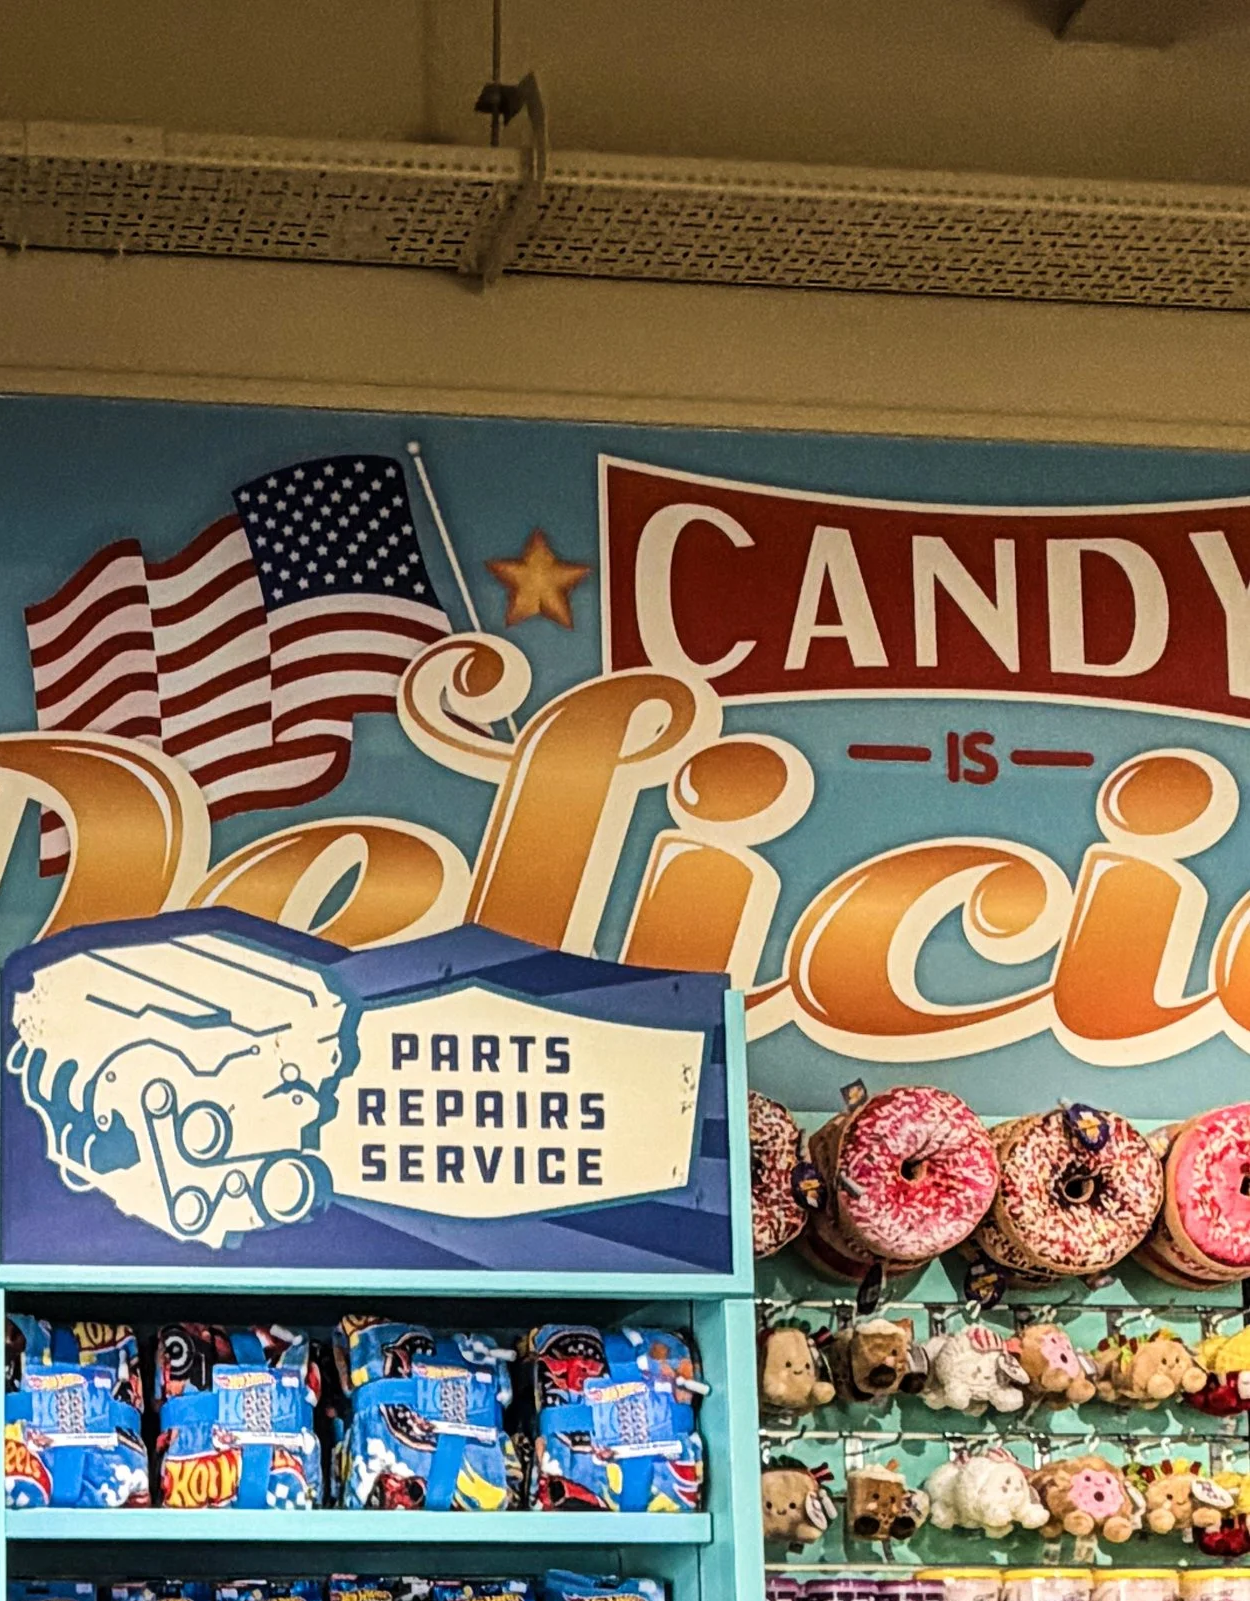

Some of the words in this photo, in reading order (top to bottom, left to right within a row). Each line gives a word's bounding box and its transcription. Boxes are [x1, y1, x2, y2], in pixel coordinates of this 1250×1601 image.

[947, 731, 999, 785] IS
[391, 1032, 571, 1074] PARTS
[357, 1087, 605, 1130] REPAIRS
[361, 1144, 603, 1186] SERVICE
